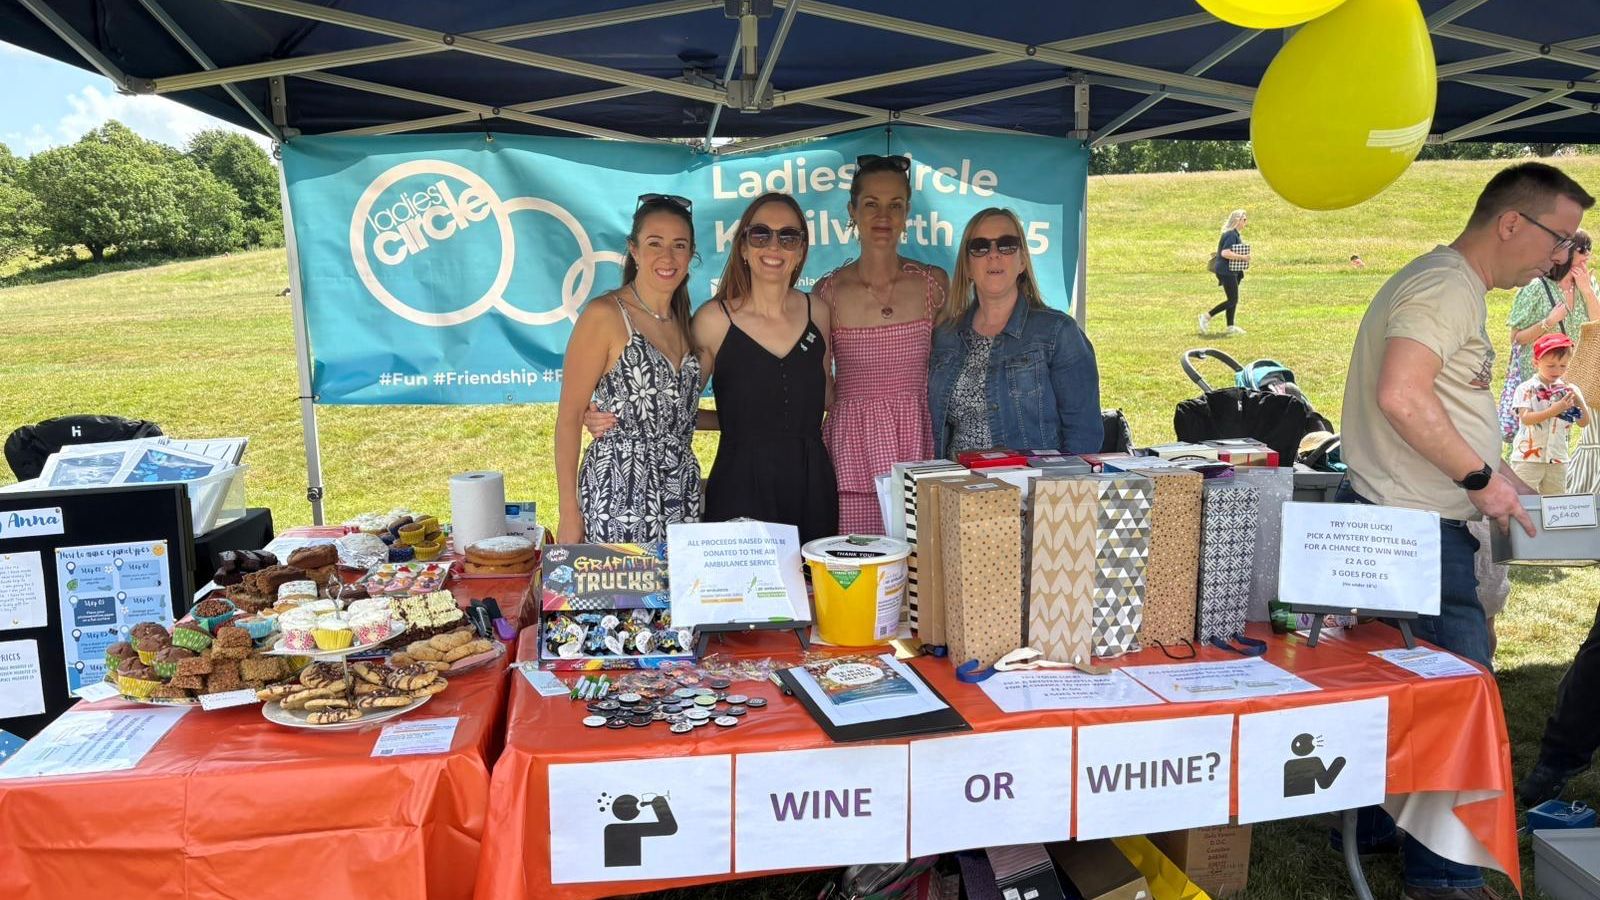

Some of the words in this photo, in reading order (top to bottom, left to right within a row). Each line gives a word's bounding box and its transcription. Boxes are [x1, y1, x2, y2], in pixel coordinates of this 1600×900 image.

[712, 157, 857, 199] Ladies
[903, 153, 998, 197] ircle
[367, 185, 443, 234] ladies
[373, 180, 491, 265] circle
[715, 209, 953, 253] Kilwrth
[379, 372, 428, 386] #Fun
[433, 369, 538, 387] #Friendship
[8, 513, 59, 528] Anna
[1346, 521, 1368, 529] YOUR
[1370, 523, 1393, 531] LUCK!
[1306, 532, 1323, 540] PICK
[1333, 533, 1369, 542] MYSTERY
[1371, 535, 1399, 545] BOTTLE
[1401, 538, 1417, 546] BAG
[1329, 544, 1361, 553] CHANCE
[1362, 546, 1373, 554] TO
[1375, 547, 1392, 555] WIN
[1393, 549, 1418, 557] WINE!
[704, 560, 748, 568] AMBULANCE
[750, 559, 776, 567] SERVICE
[574, 571, 656, 594] TRUCKS
[1338, 570, 1360, 578] GOES
[1361, 571, 1377, 579] FOR
[0, 653, 21, 662] RICES
[1086, 751, 1221, 794] WHINE?
[964, 771, 1015, 803] OR
[770, 787, 873, 822] WINE
